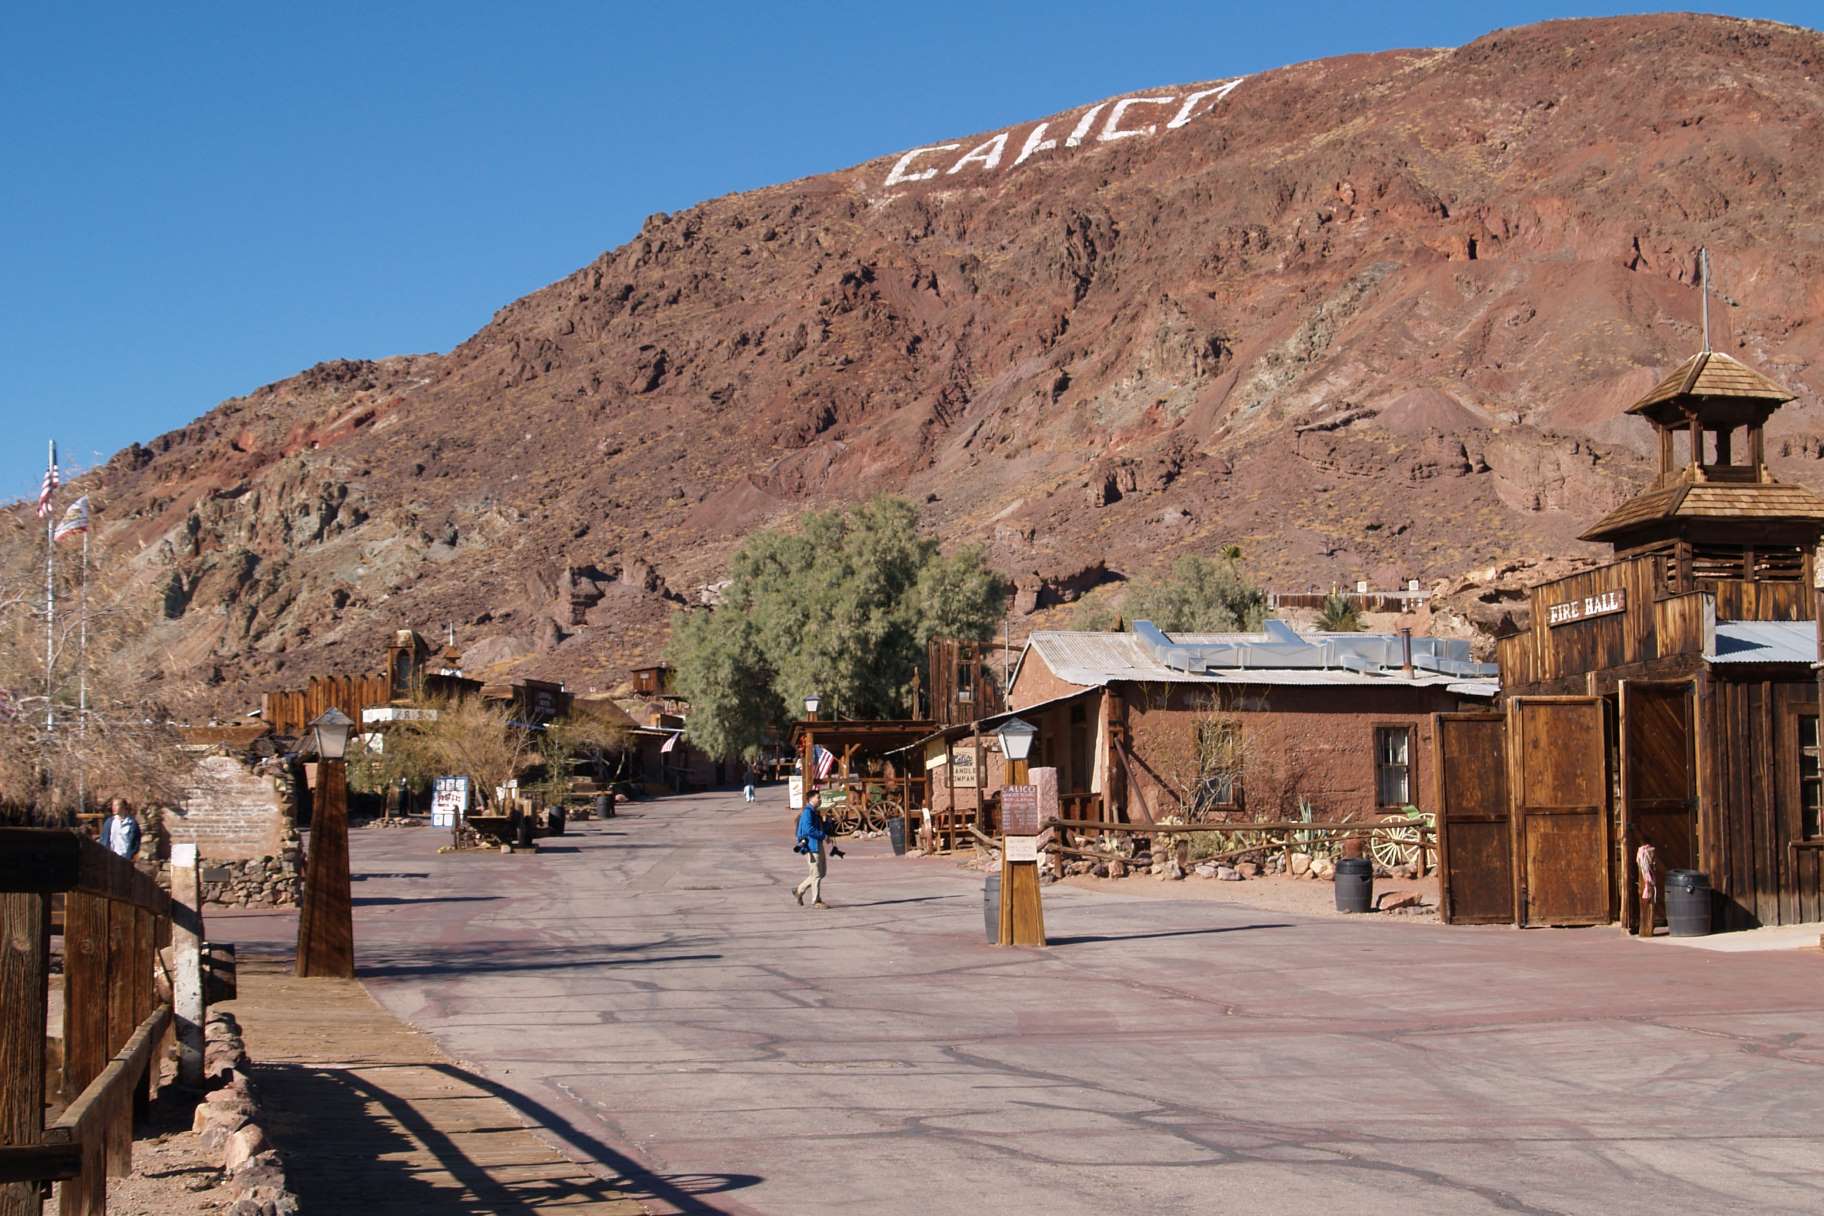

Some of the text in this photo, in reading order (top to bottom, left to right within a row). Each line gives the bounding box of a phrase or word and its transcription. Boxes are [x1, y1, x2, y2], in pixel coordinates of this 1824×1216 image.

[884, 78, 1244, 187] CALICO
[1549, 592, 1618, 623] FIRE HALL
[1002, 785, 1036, 793] CALICO
